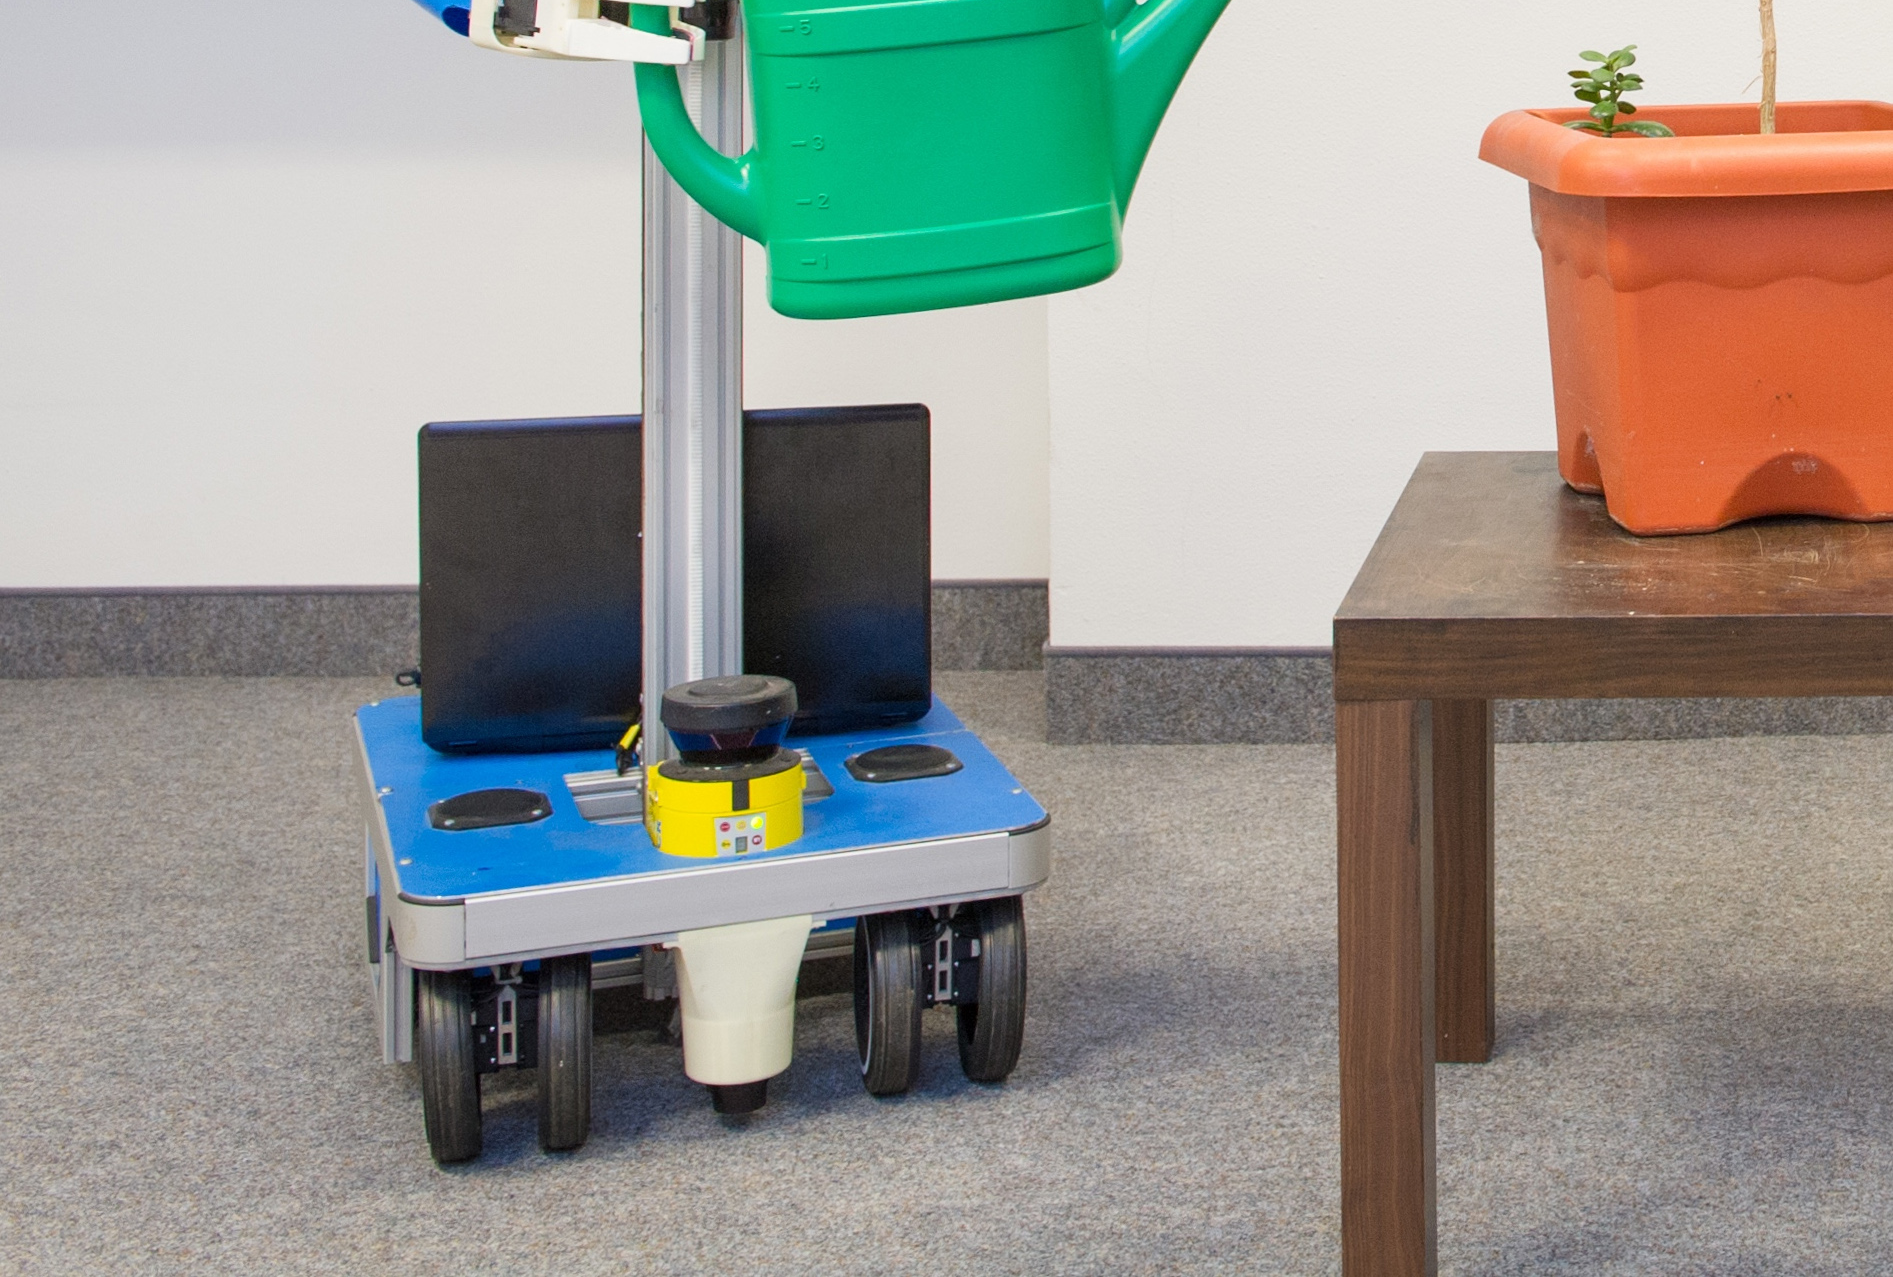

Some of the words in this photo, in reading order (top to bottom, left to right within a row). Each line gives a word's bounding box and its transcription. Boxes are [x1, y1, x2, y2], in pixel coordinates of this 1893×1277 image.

[800, 19, 812, 36] 5
[807, 76, 820, 93] 4
[812, 134, 825, 151] 3
[817, 193, 830, 210] 2
[821, 253, 829, 270] 1
